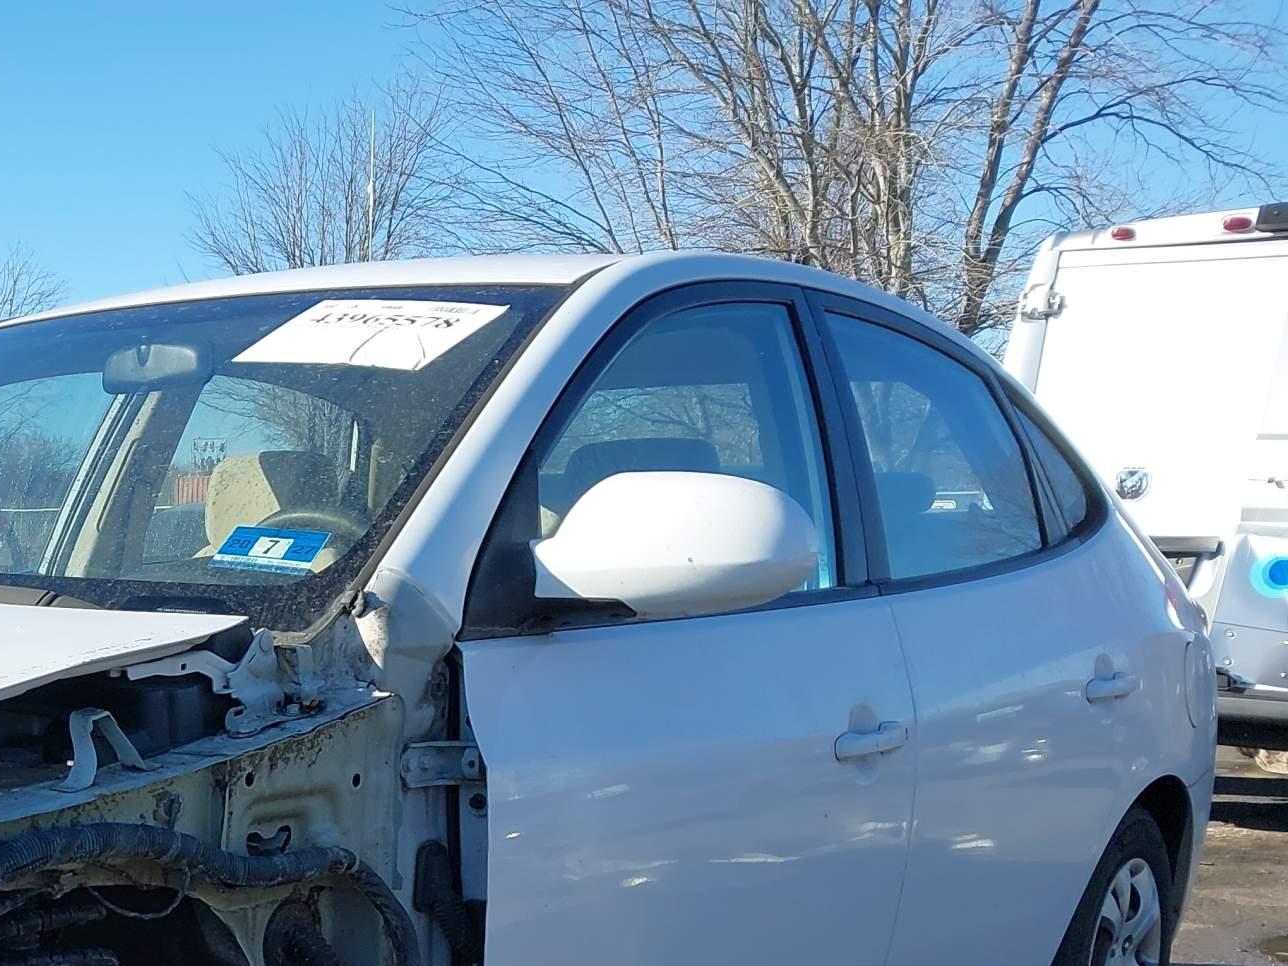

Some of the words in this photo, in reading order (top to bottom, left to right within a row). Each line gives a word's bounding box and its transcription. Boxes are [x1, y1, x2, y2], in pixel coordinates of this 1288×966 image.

[311, 312, 461, 329] 43965578
[262, 539, 281, 555] 7
[291, 545, 317, 555] 27
